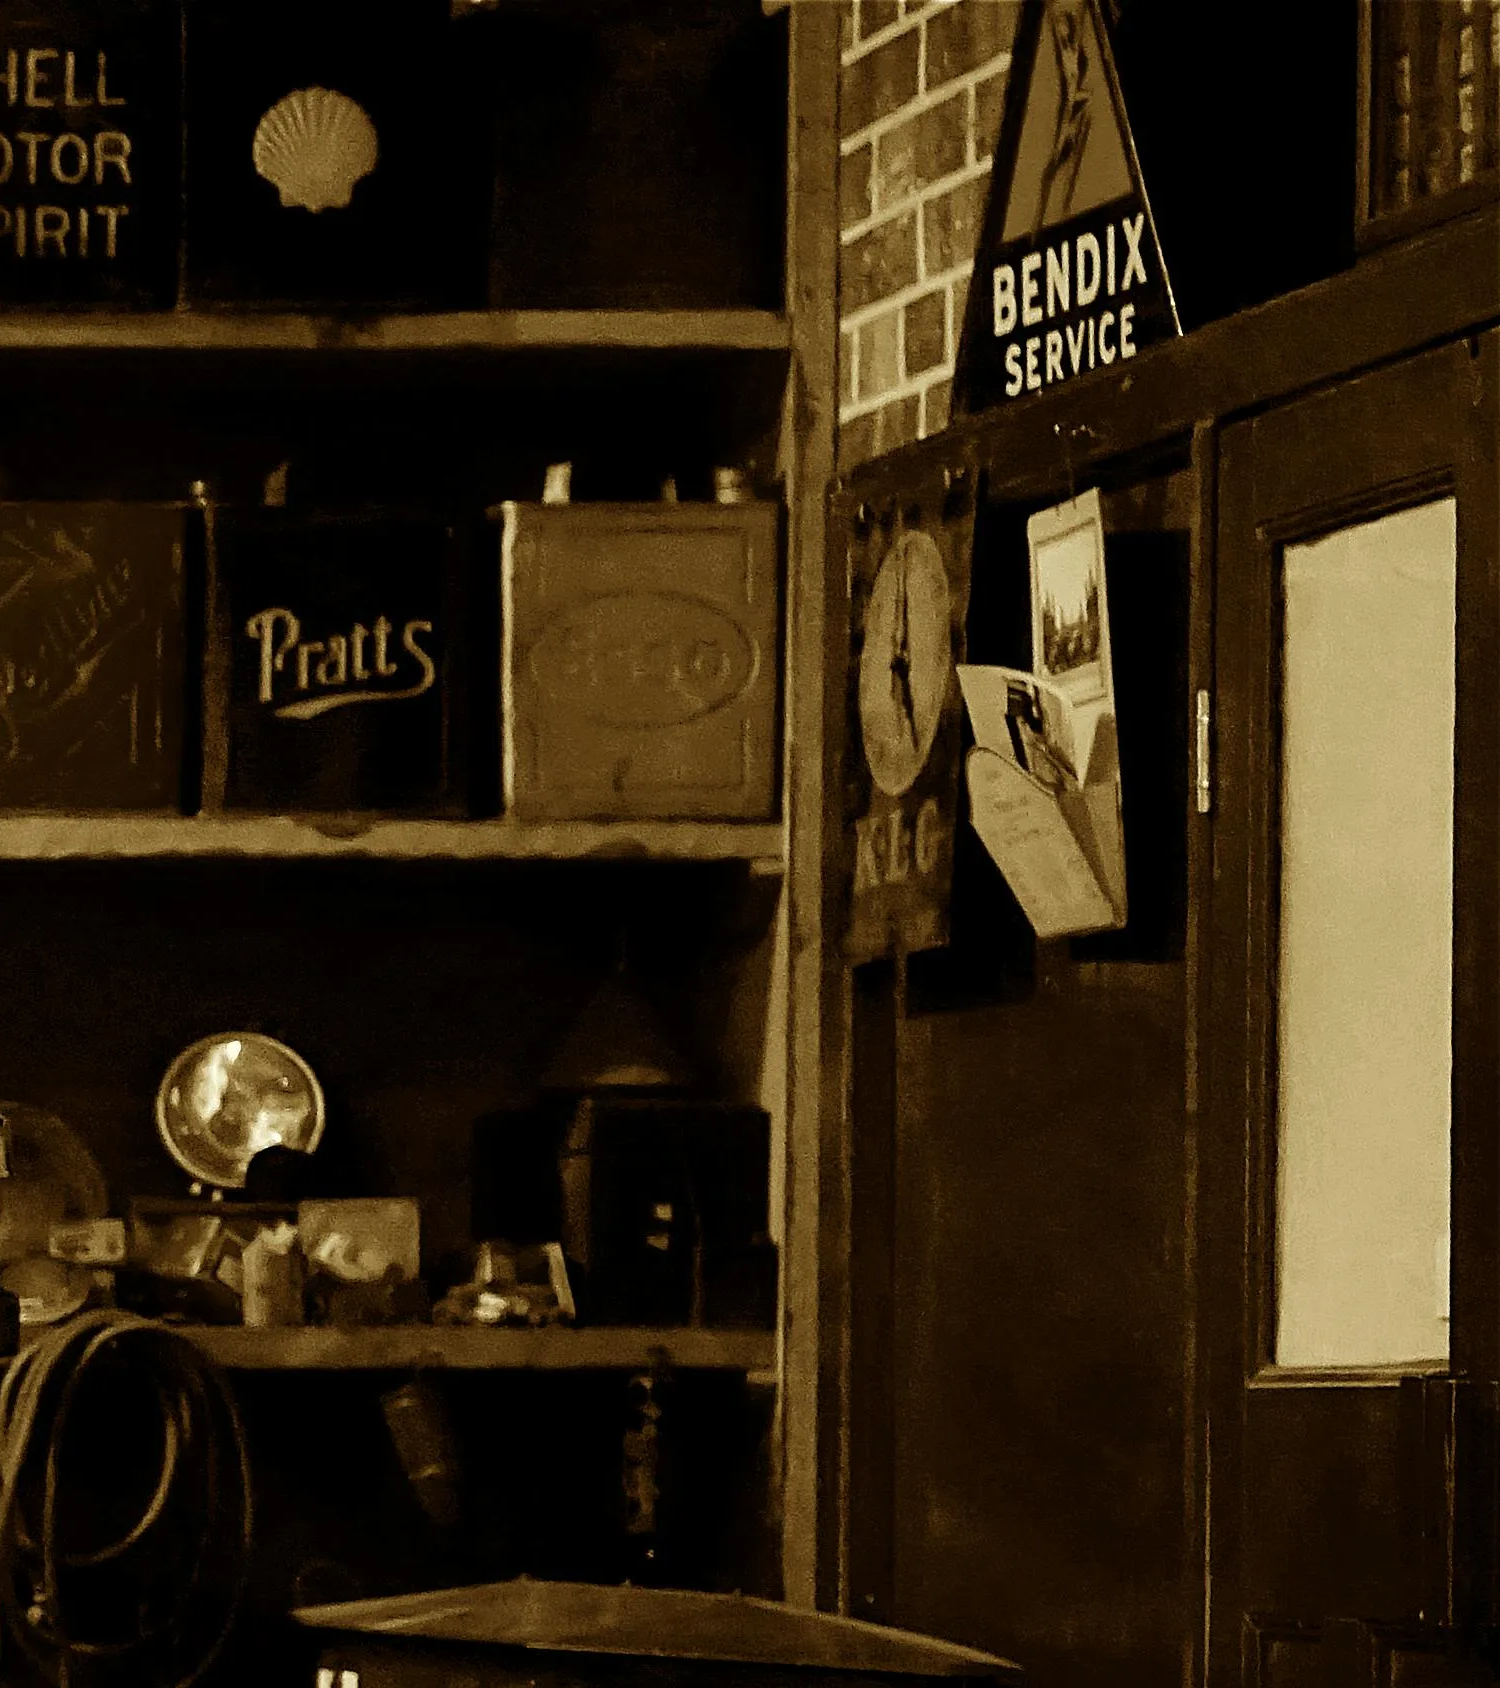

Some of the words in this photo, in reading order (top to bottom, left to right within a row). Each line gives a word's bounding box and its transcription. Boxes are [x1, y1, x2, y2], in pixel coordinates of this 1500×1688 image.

[993, 212, 1148, 338] BENDIX
[1005, 302, 1138, 397] SERVICE
[245, 607, 436, 721] Pratts
